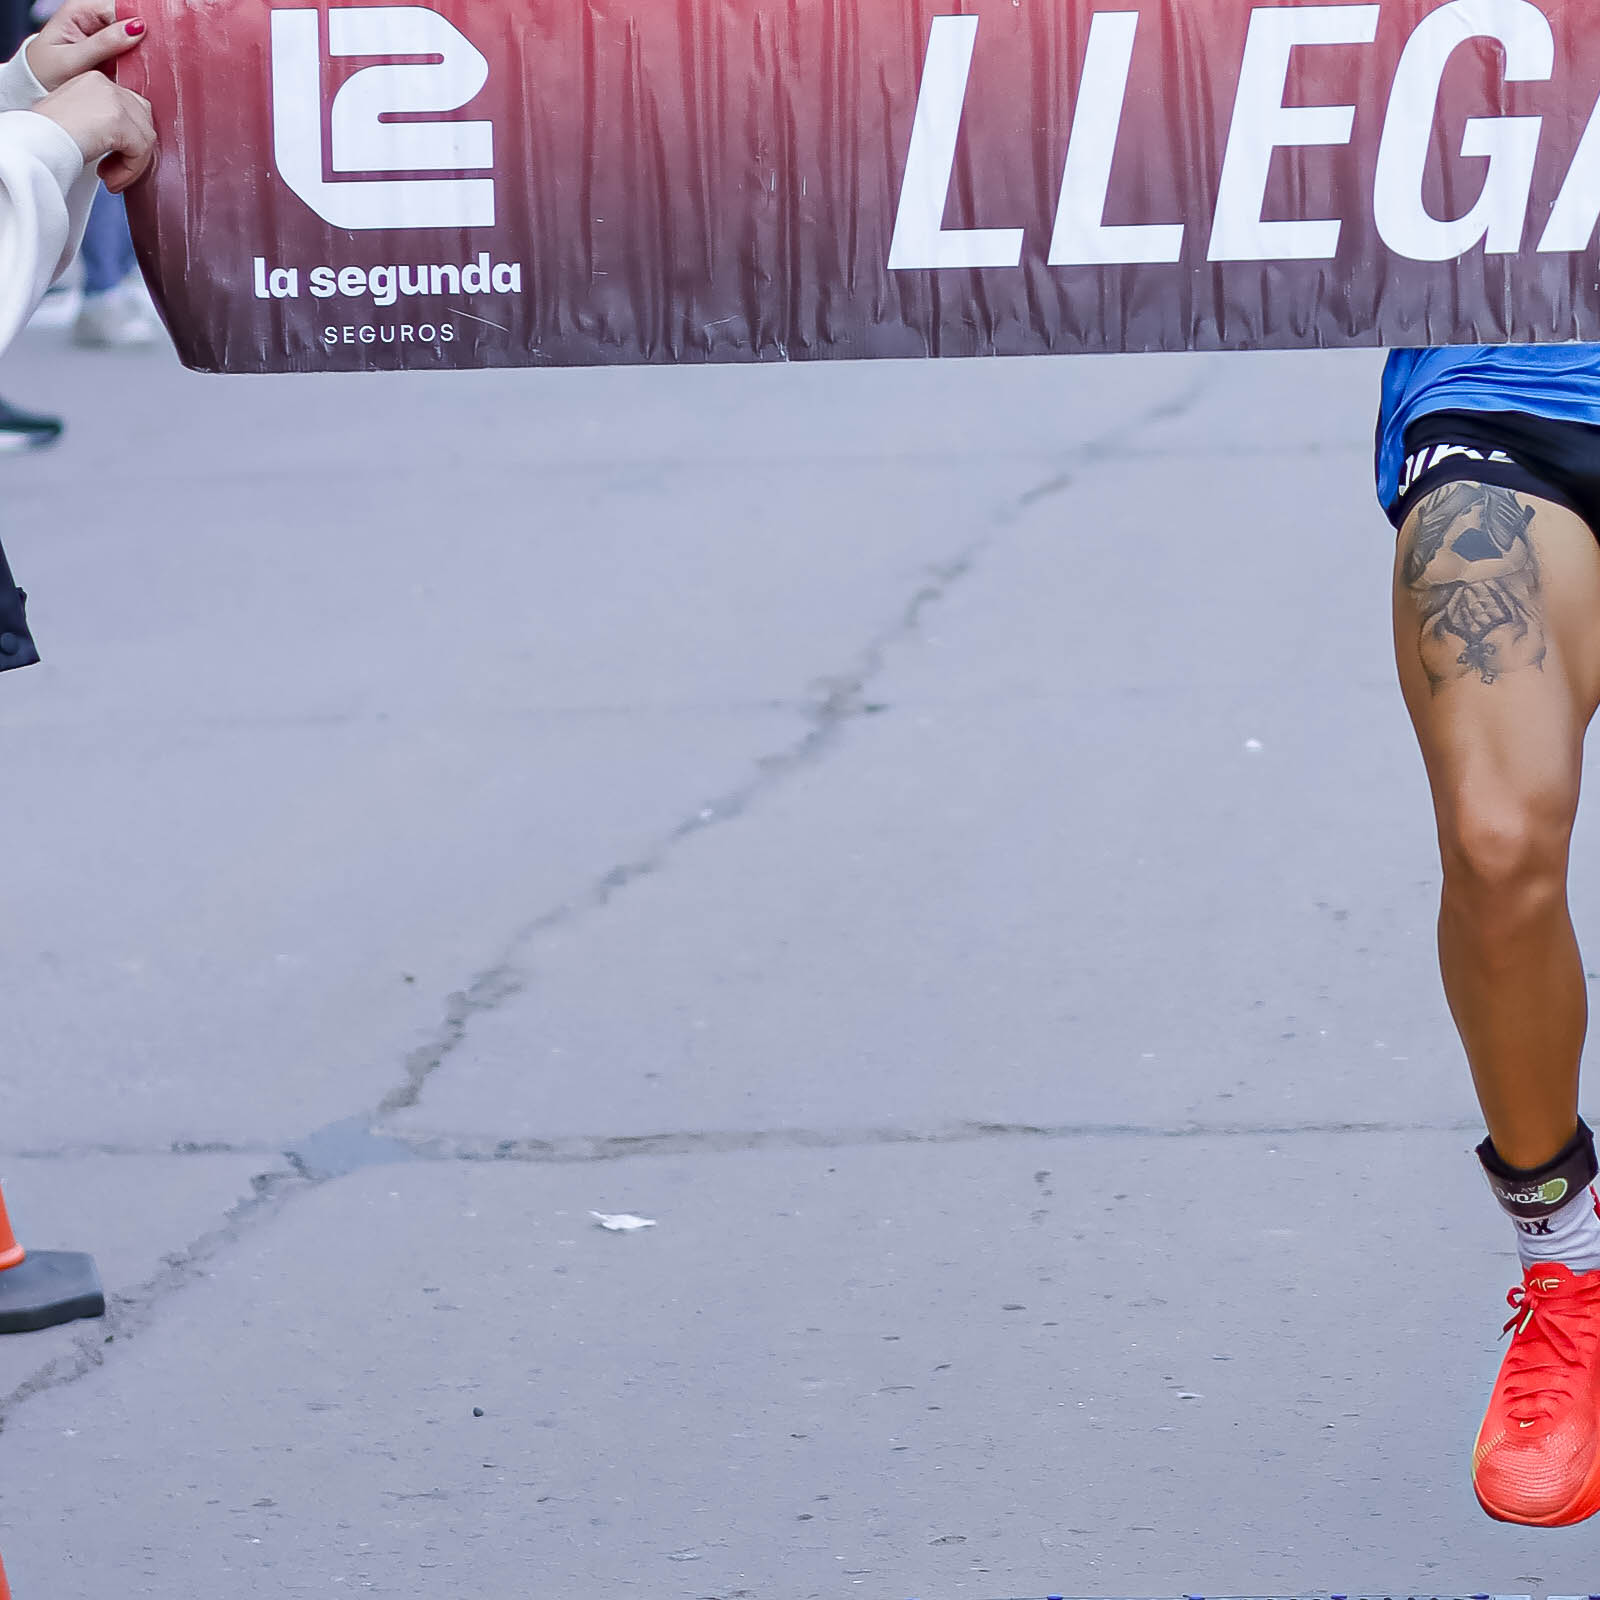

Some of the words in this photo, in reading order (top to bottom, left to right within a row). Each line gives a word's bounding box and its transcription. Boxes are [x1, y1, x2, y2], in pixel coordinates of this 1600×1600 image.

[253, 256, 300, 300] la
[308, 251, 523, 307] segunda
[323, 323, 455, 345] SEGUROS
